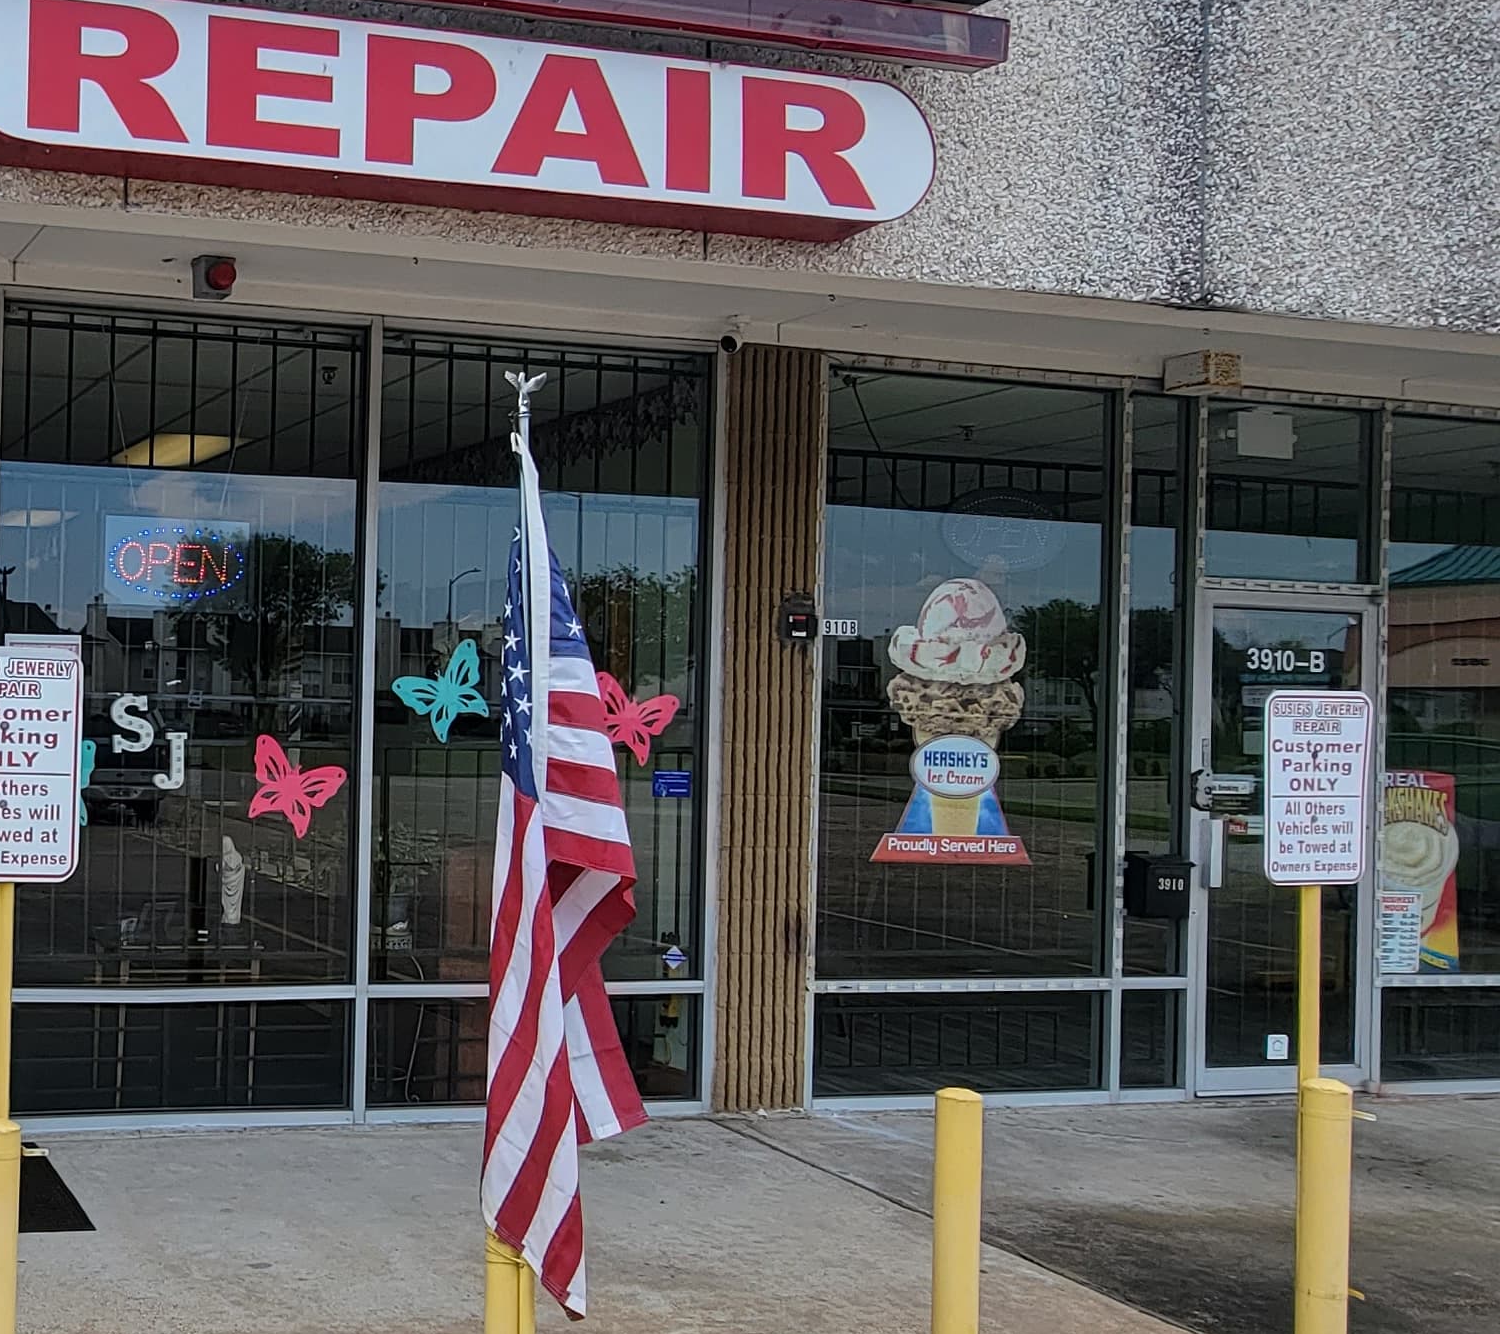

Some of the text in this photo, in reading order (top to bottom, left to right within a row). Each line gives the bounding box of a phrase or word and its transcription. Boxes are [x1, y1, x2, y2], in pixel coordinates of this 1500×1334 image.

[117, 541, 229, 584] OPEN
[1246, 648, 1325, 673] 3910-B
[5, 660, 73, 678] JEWERLY
[1273, 702, 1364, 717] SUSIE'S JEWERLY
[1293, 720, 1340, 733] REPAIR
[1272, 739, 1363, 754] Customer
[923, 750, 989, 769] HERSHEY'S
[1282, 759, 1353, 775] Parking
[927, 770, 986, 785] Ice Cream
[1289, 778, 1338, 792] ONLY
[1385, 772, 1430, 788] REAL
[29, 804, 61, 820] will
[1285, 802, 1346, 816] All Others
[1385, 787, 1449, 835] KSHAKES
[40, 829, 58, 843] at
[1277, 821, 1353, 836] Vehicles will
[887, 838, 1017, 855] Proudly Served Here
[1279, 840, 1352, 854] be Towed at
[1, 851, 67, 867] Expense
[1271, 860, 1358, 875] Owners Expense
[1158, 877, 1184, 891] 3910
